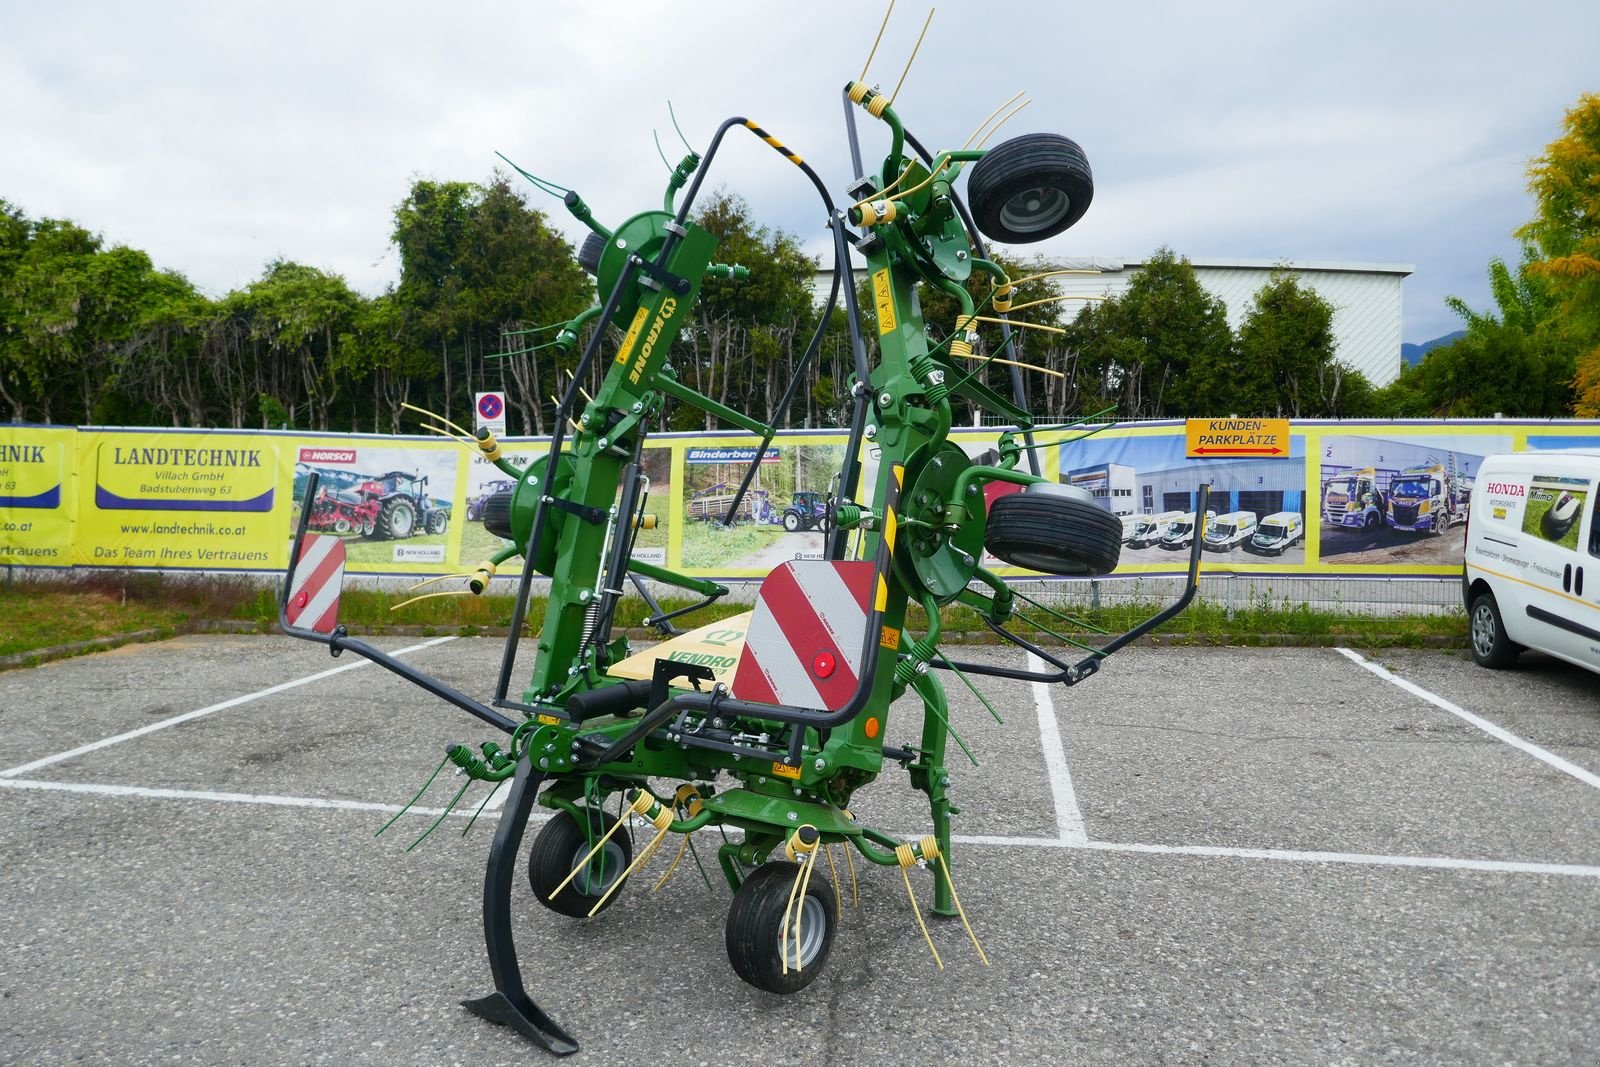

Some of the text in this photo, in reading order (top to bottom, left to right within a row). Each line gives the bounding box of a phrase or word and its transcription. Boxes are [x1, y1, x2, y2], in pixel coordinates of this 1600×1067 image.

[629, 315, 665, 385] KRONE
[1209, 421, 1267, 431] KUNDEN-
[1199, 432, 1277, 445] PARKPLÄTZE
[114, 447, 262, 467] LANDTECHNIK
[311, 452, 354, 461] HORSCH
[690, 450, 778, 459] Binderberer
[155, 471, 224, 481] Villach GmbH
[140, 484, 232, 496] Badstubenweg 63
[1487, 483, 1525, 496] HONDA
[120, 522, 246, 536] www.landtechnik.co.at
[94, 546, 268, 561] Das Team Ihres Vertrauens
[668, 651, 737, 668] VENDRO
